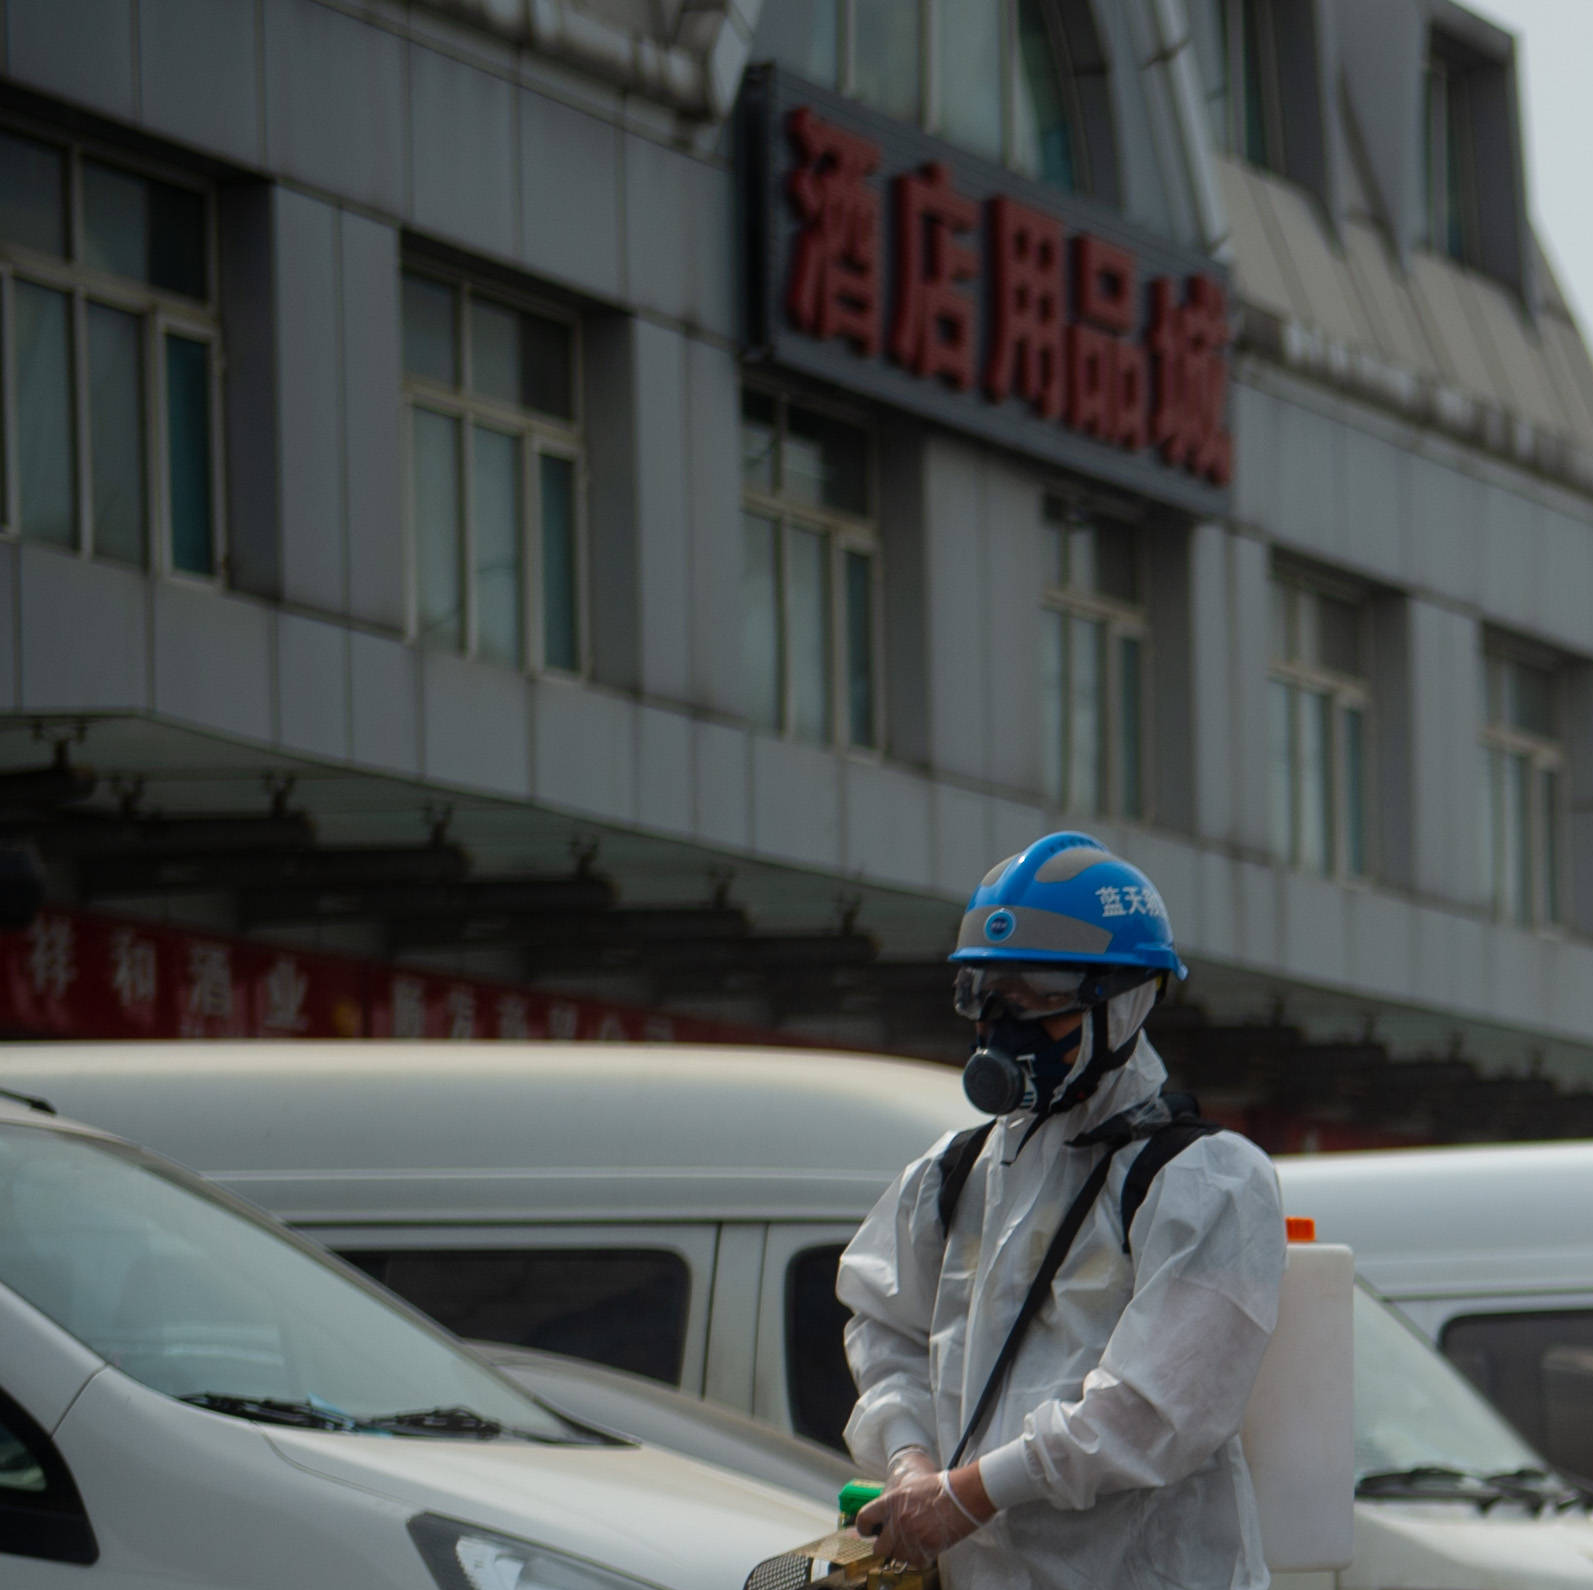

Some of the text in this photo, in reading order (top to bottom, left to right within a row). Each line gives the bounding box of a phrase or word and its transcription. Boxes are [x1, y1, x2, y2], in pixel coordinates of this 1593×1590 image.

[787, 106, 1233, 488] 酒店用品城
